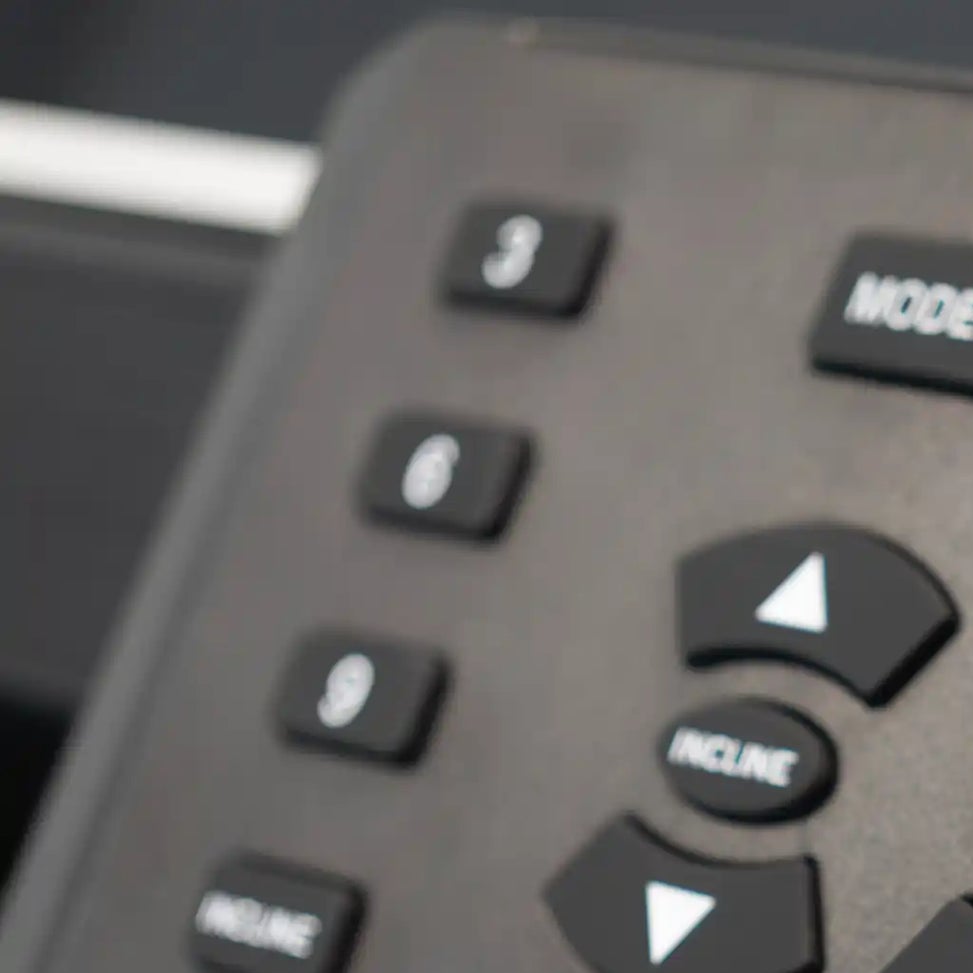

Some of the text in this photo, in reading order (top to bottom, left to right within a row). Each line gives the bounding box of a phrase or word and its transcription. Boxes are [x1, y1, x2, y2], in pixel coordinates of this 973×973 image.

[482, 215, 543, 289] 3
[402, 433, 460, 509] 6
[317, 653, 374, 728] 9
